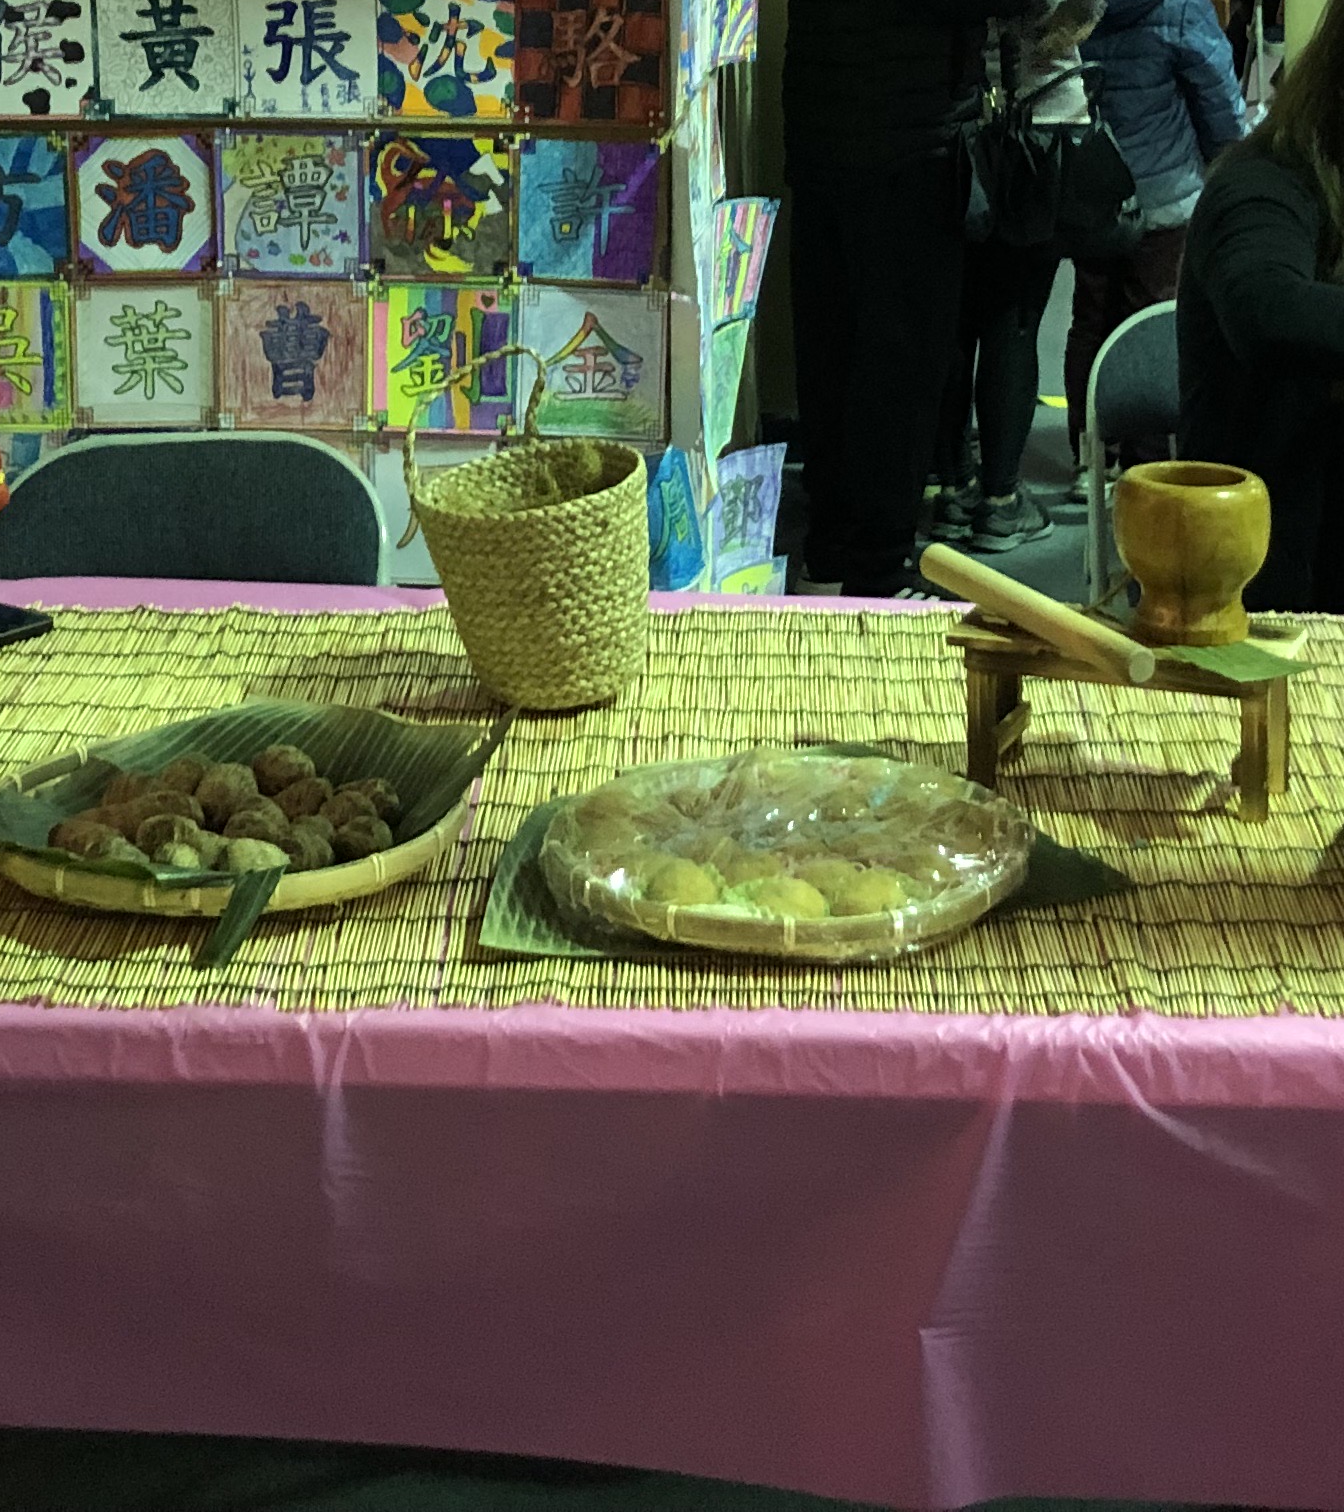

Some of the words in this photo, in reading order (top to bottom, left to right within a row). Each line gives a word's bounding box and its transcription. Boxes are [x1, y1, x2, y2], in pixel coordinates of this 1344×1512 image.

[406, 2, 497, 83] 沈
[551, 7, 642, 87] 駱
[95, 147, 195, 253] 潘
[240, 155, 337, 251] 譚
[537, 165, 634, 256] 許
[105, 300, 192, 400] 葉
[391, 308, 484, 403] 劉
[544, 311, 644, 401] 金
